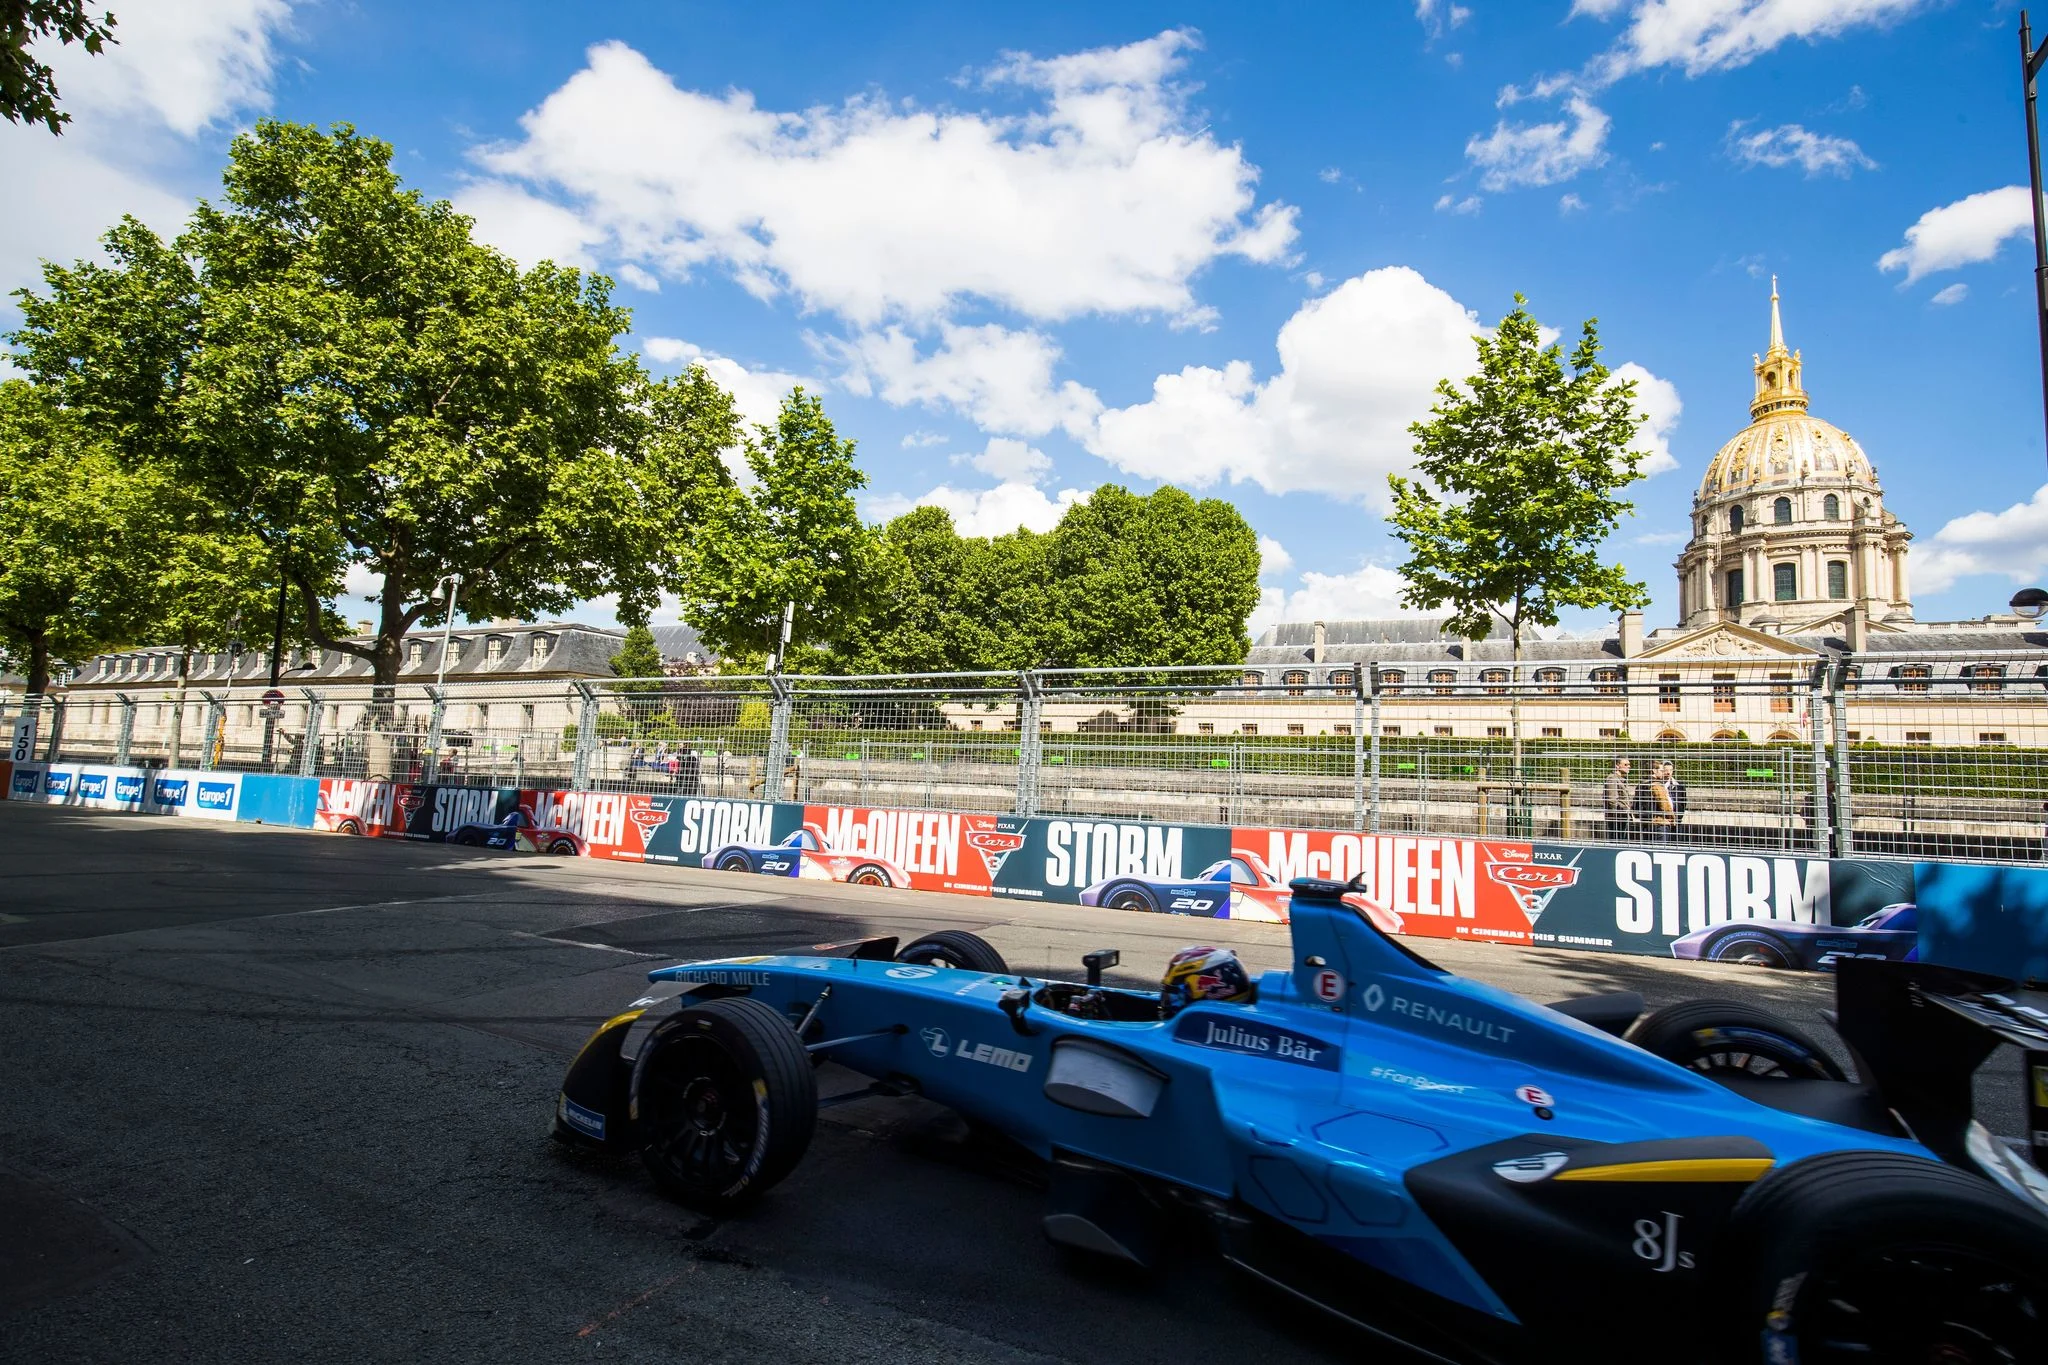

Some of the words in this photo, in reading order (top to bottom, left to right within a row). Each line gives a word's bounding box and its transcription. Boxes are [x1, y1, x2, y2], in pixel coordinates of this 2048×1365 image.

[15, 724, 29, 761] 150
[432, 787, 499, 832] STORM
[535, 791, 628, 846] McQUEEN
[634, 811, 663, 822] Cars
[680, 800, 773, 854] STORM
[826, 808, 961, 876] McQUEEN
[972, 834, 1017, 848] Cars
[987, 855, 1001, 871] 3
[1045, 821, 1183, 888] STORM
[1500, 848, 1530, 861] Disney
[1534, 852, 1563, 861] PIXAR
[1269, 831, 1476, 919] McQUEEN
[1497, 867, 1567, 883] Cars
[1522, 893, 1543, 913] 3
[1615, 850, 1832, 936] STORM
[1456, 926, 1469, 934] IN
[1472, 927, 1525, 939] CINEMAS
[1528, 932, 1556, 942] THIS
[1559, 934, 1613, 947] SUMMER
[675, 971, 728, 985] RICHARD
[732, 972, 771, 986] MILLE
[1321, 973, 1337, 997] E
[1205, 1020, 1270, 1051] Julius
[1391, 996, 1517, 1043] RENAULT
[955, 1039, 1033, 1073] LEMO
